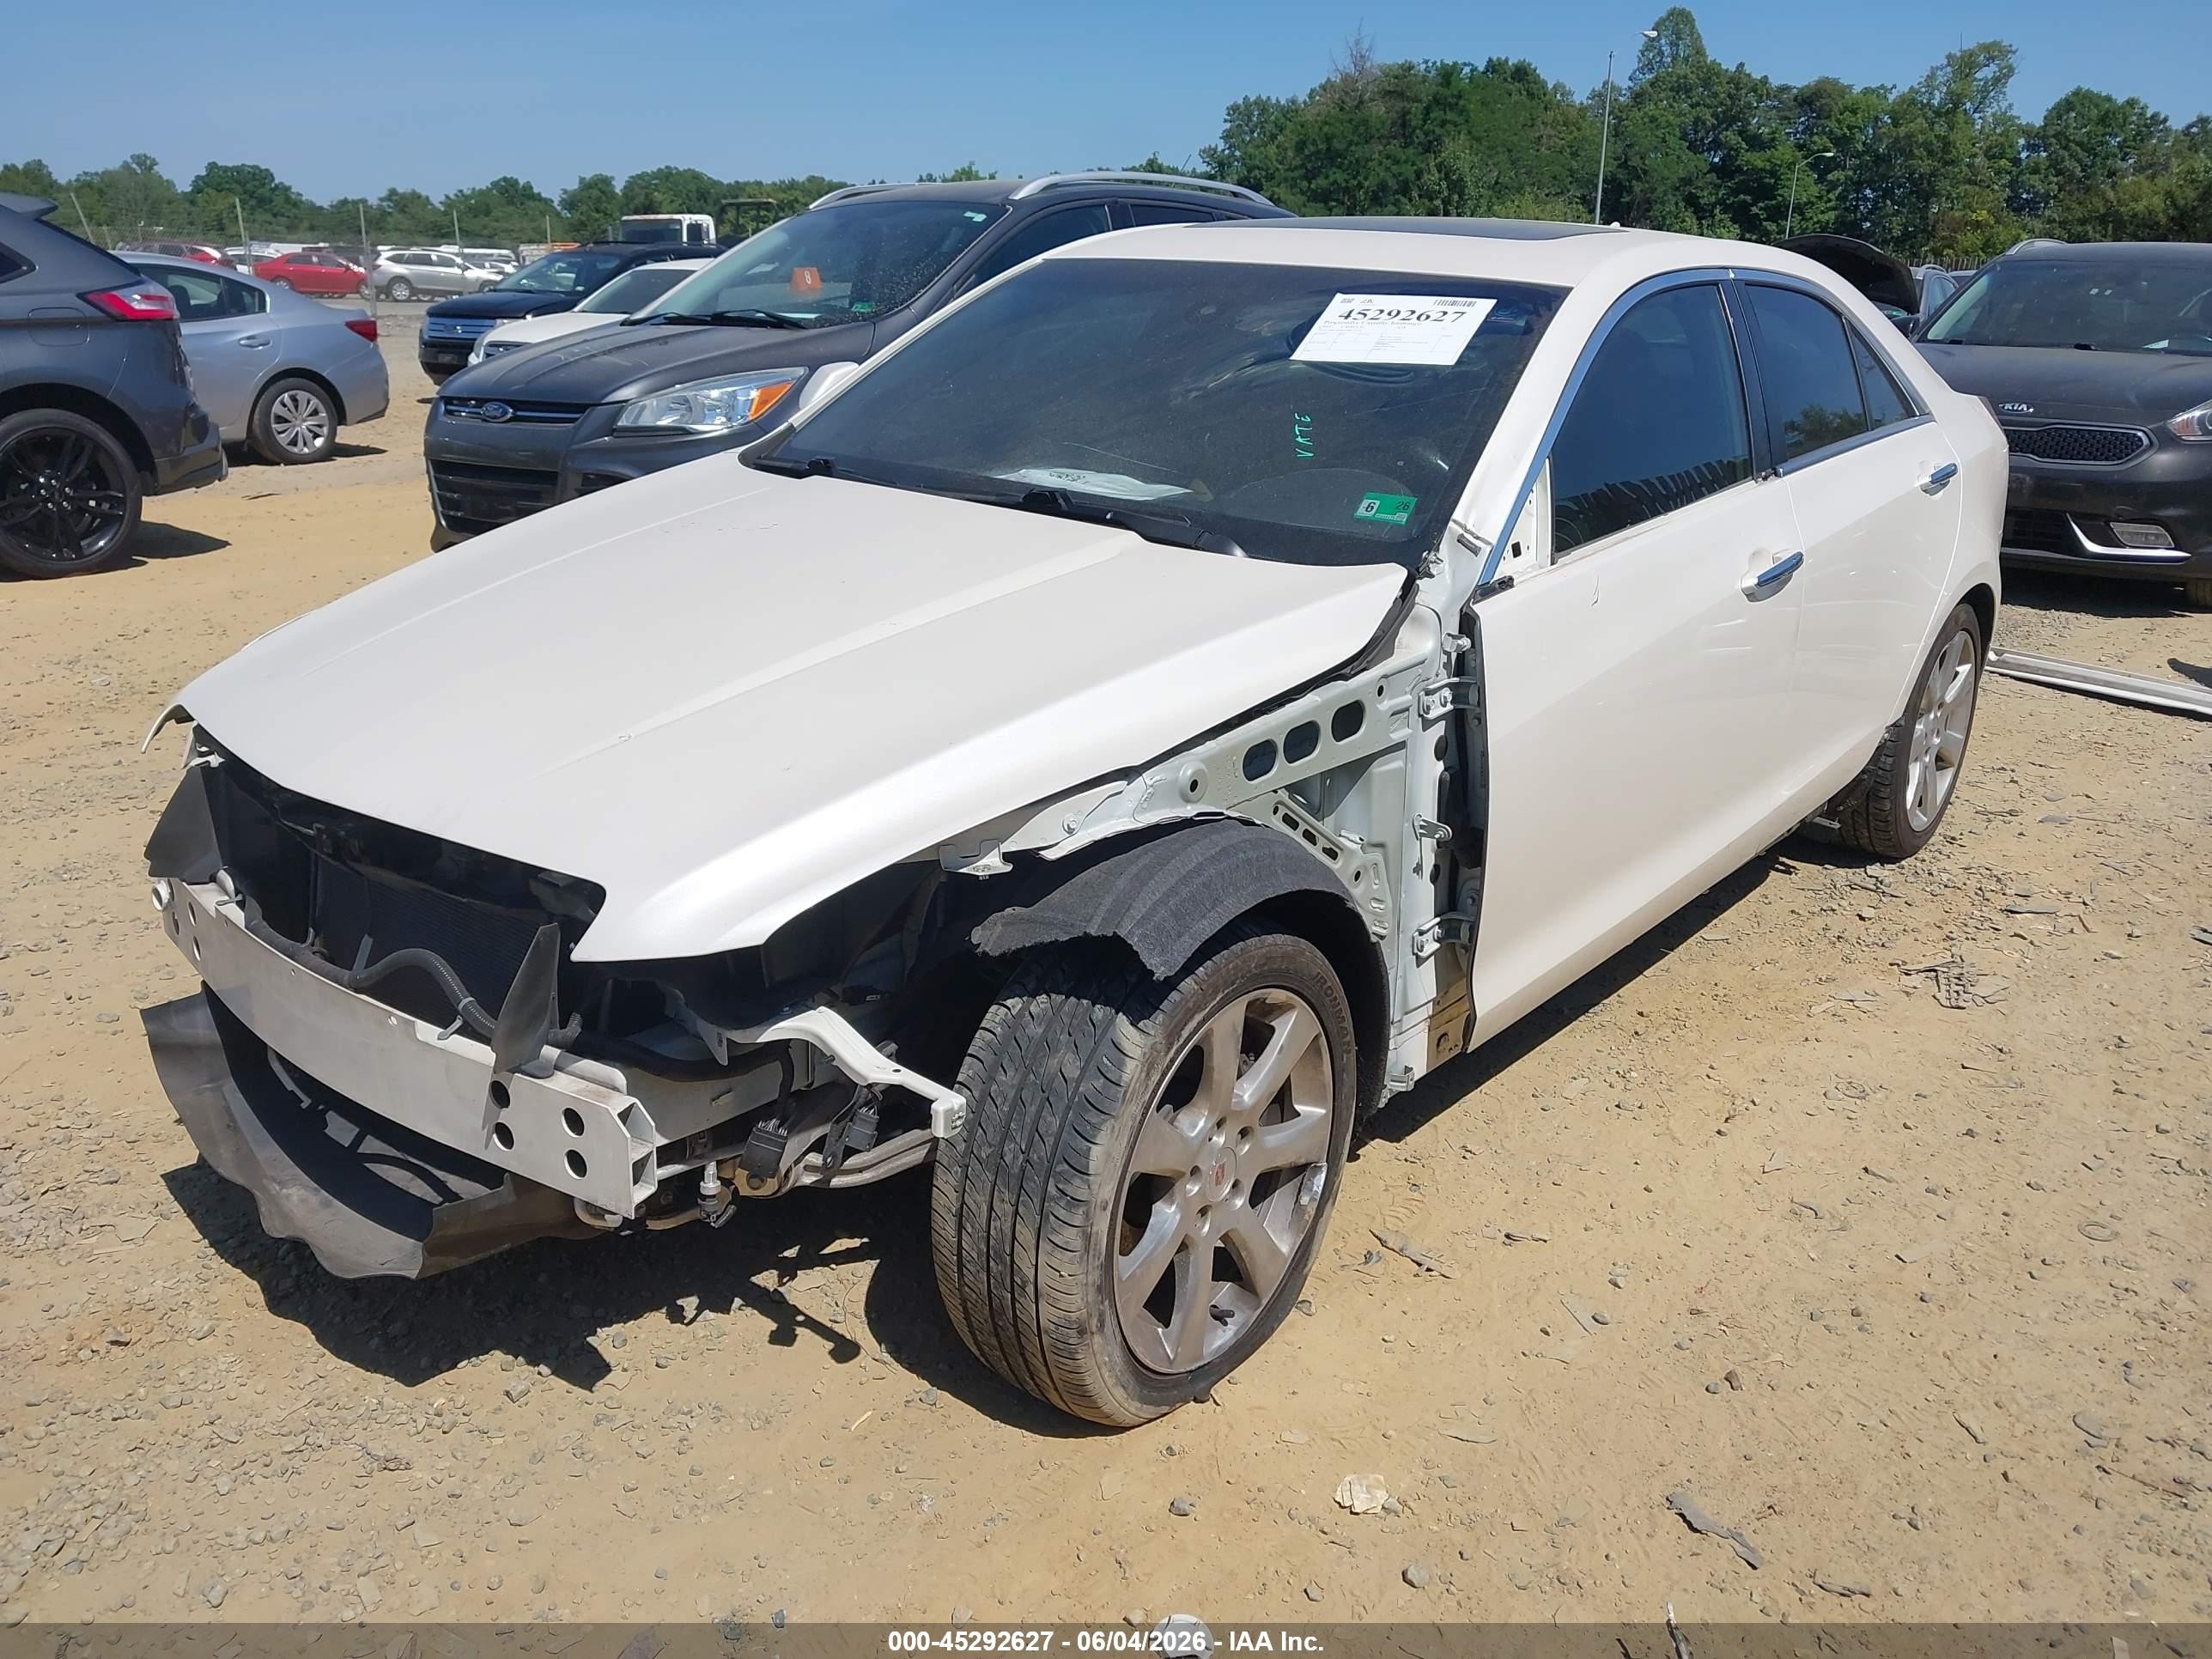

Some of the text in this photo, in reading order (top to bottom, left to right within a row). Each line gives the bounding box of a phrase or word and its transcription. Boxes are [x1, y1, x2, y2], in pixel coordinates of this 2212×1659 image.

[804, 270, 811, 285] 8
[1338, 307, 1468, 322] 45292627
[2004, 402, 2027, 411] KIA
[1365, 501, 1376, 513] 6
[1395, 501, 1410, 511] 26
[1312, 969, 1352, 1055] IRONMAN
